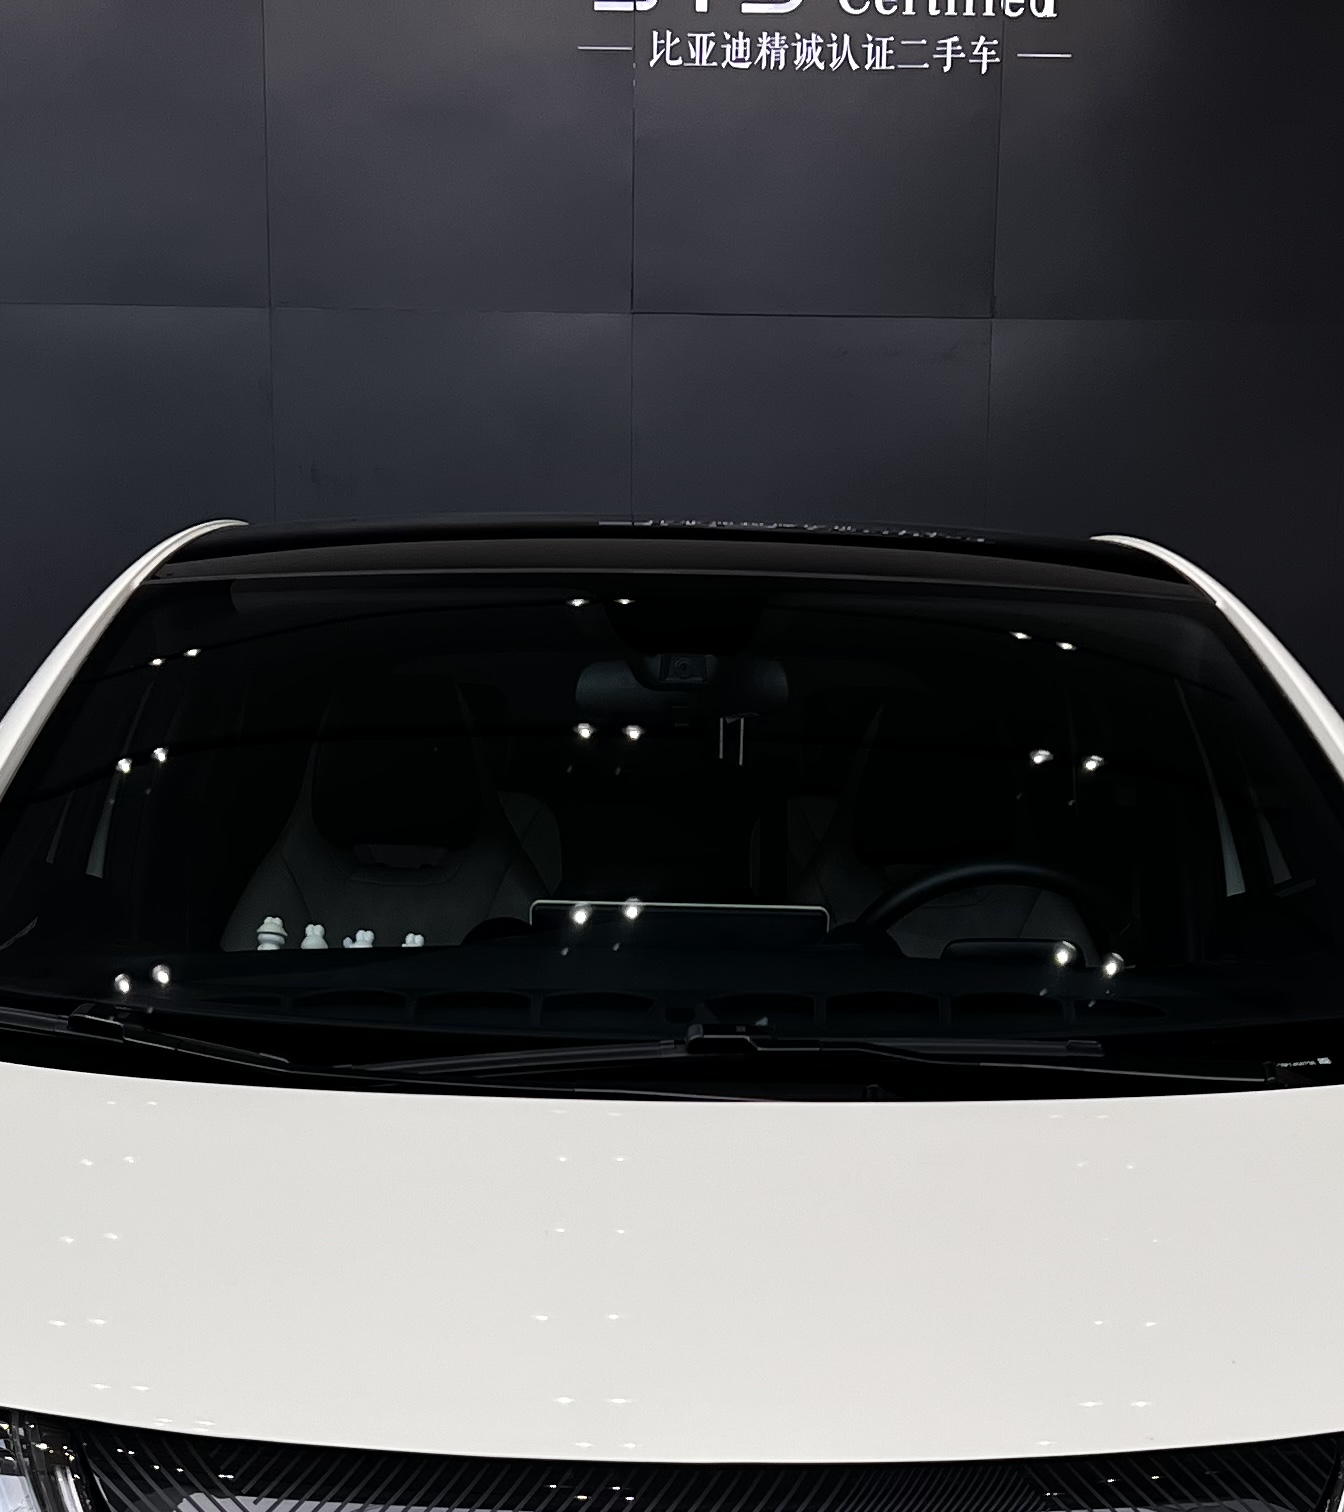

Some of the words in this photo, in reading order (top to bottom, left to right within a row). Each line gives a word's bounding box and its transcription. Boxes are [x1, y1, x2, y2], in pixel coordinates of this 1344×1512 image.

[649, 30, 1001, 75] 比亚迪精诚认证二手车
